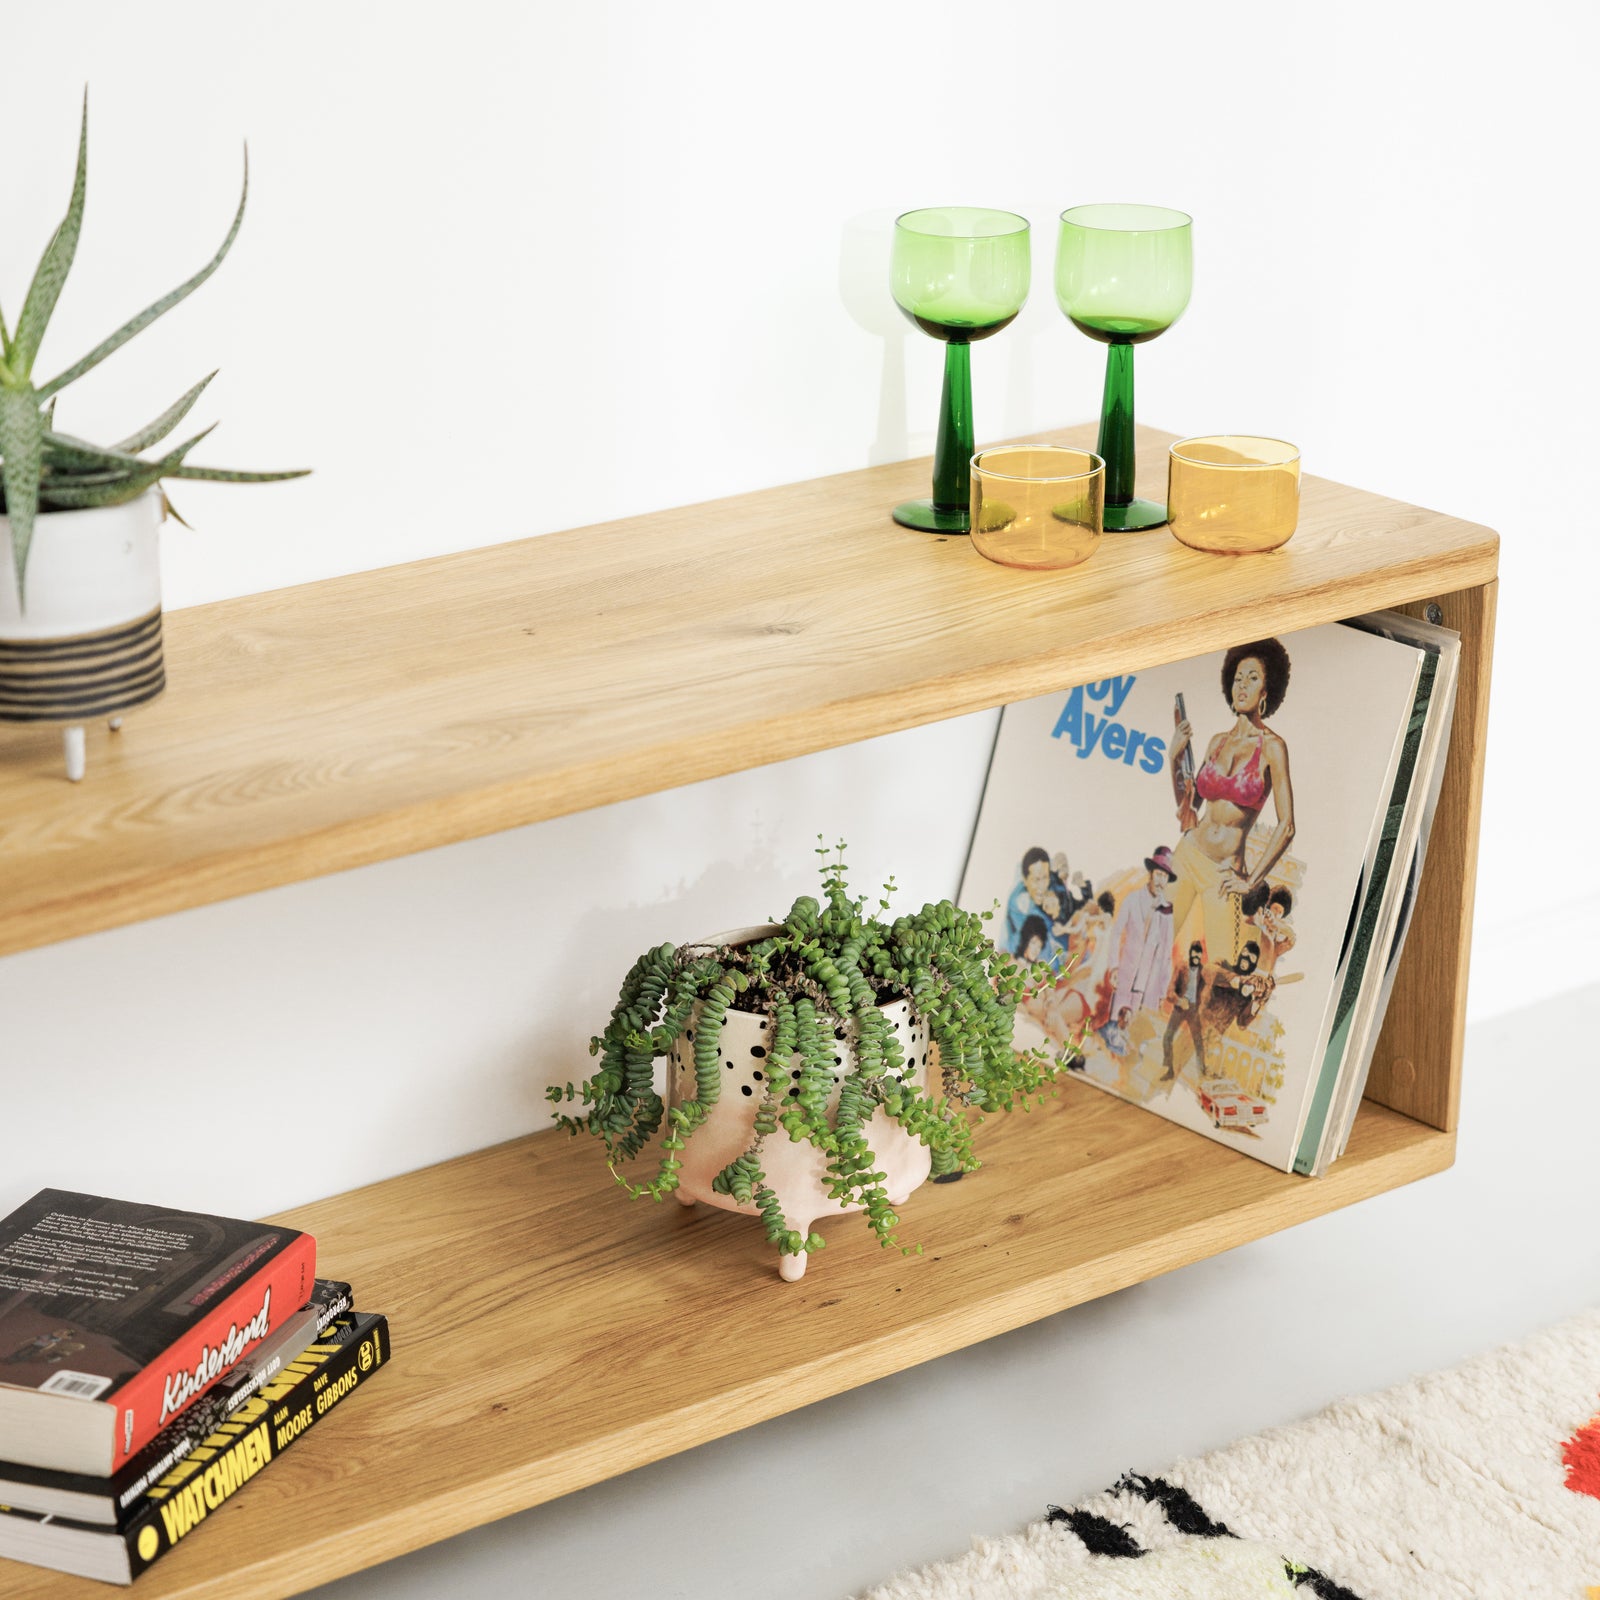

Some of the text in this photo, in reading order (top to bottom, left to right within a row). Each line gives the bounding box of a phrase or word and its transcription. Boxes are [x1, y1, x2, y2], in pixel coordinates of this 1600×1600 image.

[1082, 675, 1136, 717] oy
[1051, 685, 1166, 774] Ayers
[158, 1285, 271, 1425] Kinderland
[359, 1341, 373, 1371] DC
[313, 1373, 329, 1392] DAVE
[316, 1366, 358, 1415] GIBBONS
[273, 1406, 289, 1427] ALAN
[276, 1404, 313, 1450] MOORE
[160, 1421, 272, 1545] WATCHMEN
